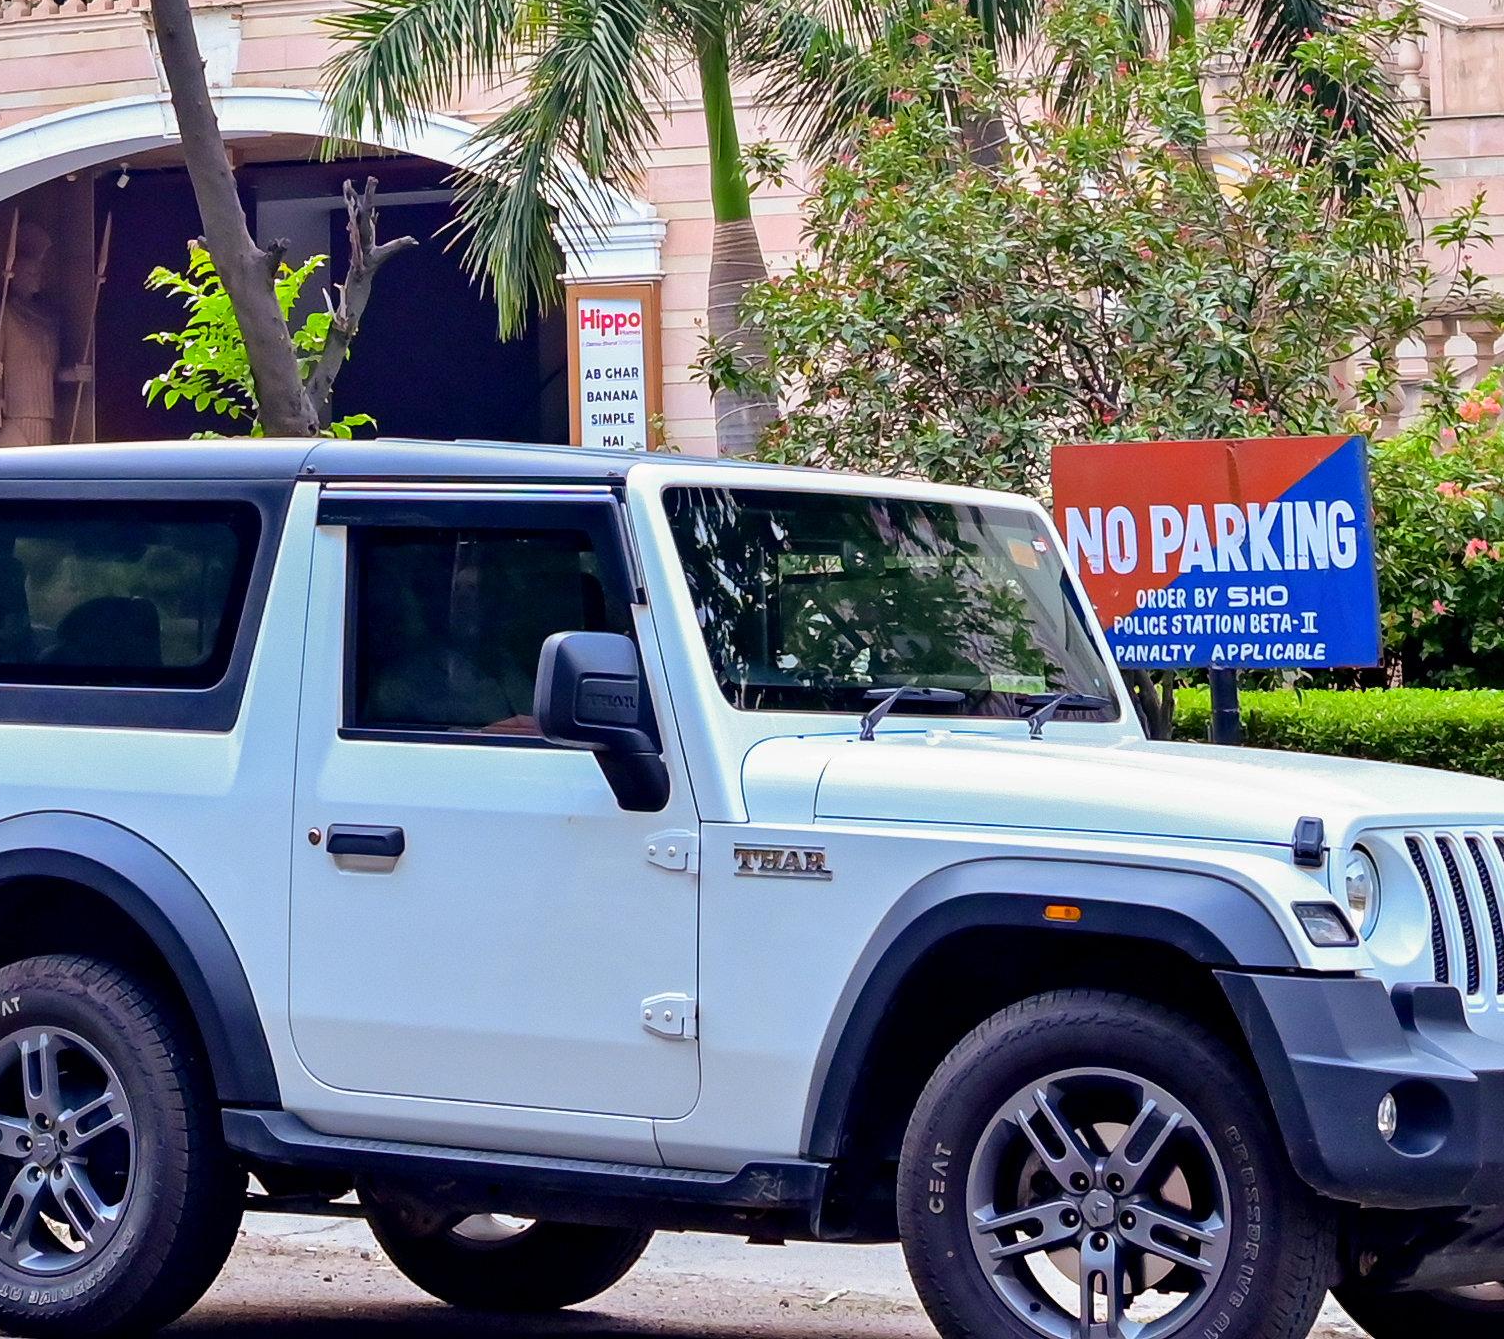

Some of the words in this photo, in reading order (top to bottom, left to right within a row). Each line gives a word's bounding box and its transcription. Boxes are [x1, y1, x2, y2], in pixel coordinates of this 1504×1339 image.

[580, 308, 641, 337] Hippo
[585, 368, 601, 381] AB
[605, 367, 639, 379] GHAR
[586, 390, 639, 403] BANANA
[591, 412, 635, 425] SIMPLE
[602, 435, 624, 447] HAI
[1064, 505, 1138, 575] NO
[1148, 499, 1358, 574] PARKING
[1135, 587, 1187, 609] ORDER
[1194, 586, 1219, 608] BY
[1227, 585, 1289, 608] SHO
[1113, 615, 1168, 636] POLICE
[1170, 613, 1246, 636] STATION
[1114, 643, 1196, 662] PANALTY
[1210, 642, 1327, 662] APPLICABLE
[733, 847, 833, 877] THAR
[928, 1141, 952, 1214] CEAT
